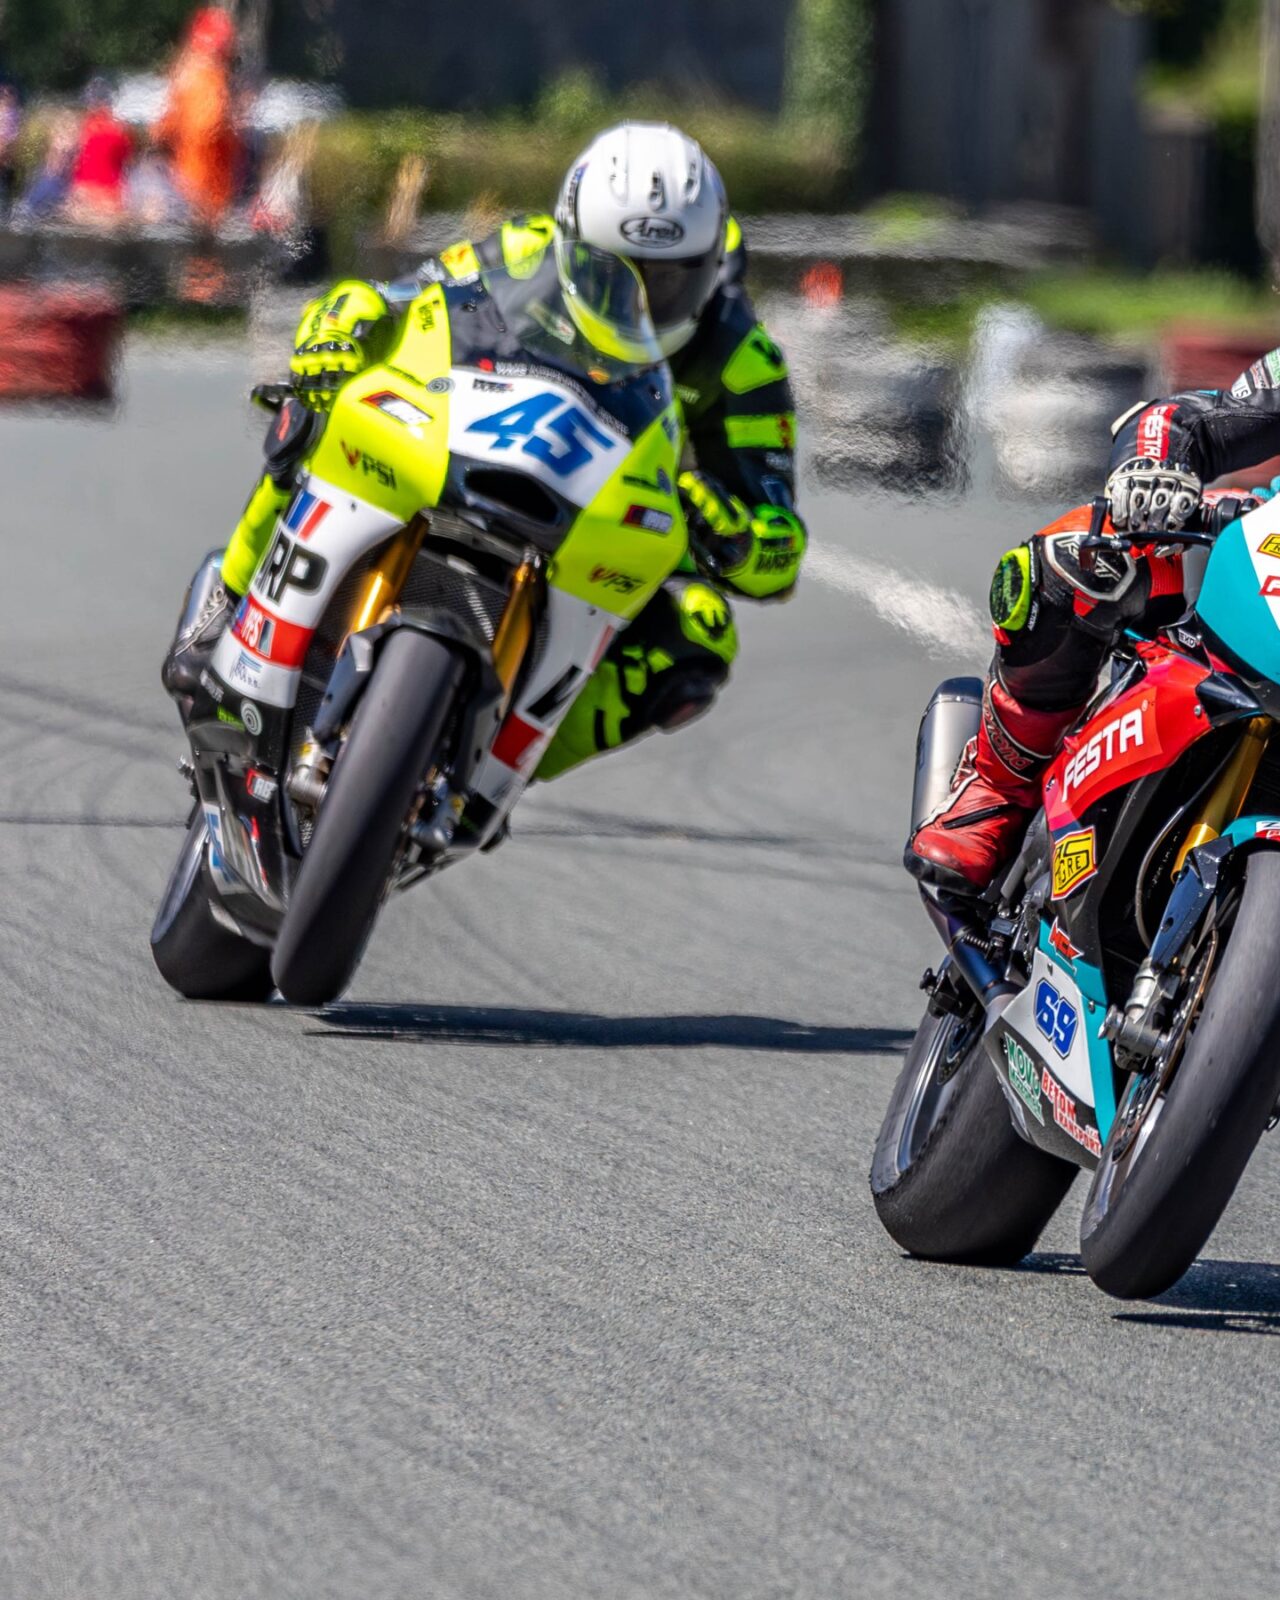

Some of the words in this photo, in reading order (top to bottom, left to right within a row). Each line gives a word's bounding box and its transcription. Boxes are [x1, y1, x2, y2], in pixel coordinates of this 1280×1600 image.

[464, 392, 616, 477] 45
[1062, 708, 1143, 803] FESTA
[1034, 978, 1079, 1059] 69
[1042, 1068, 1077, 1122] BETON
